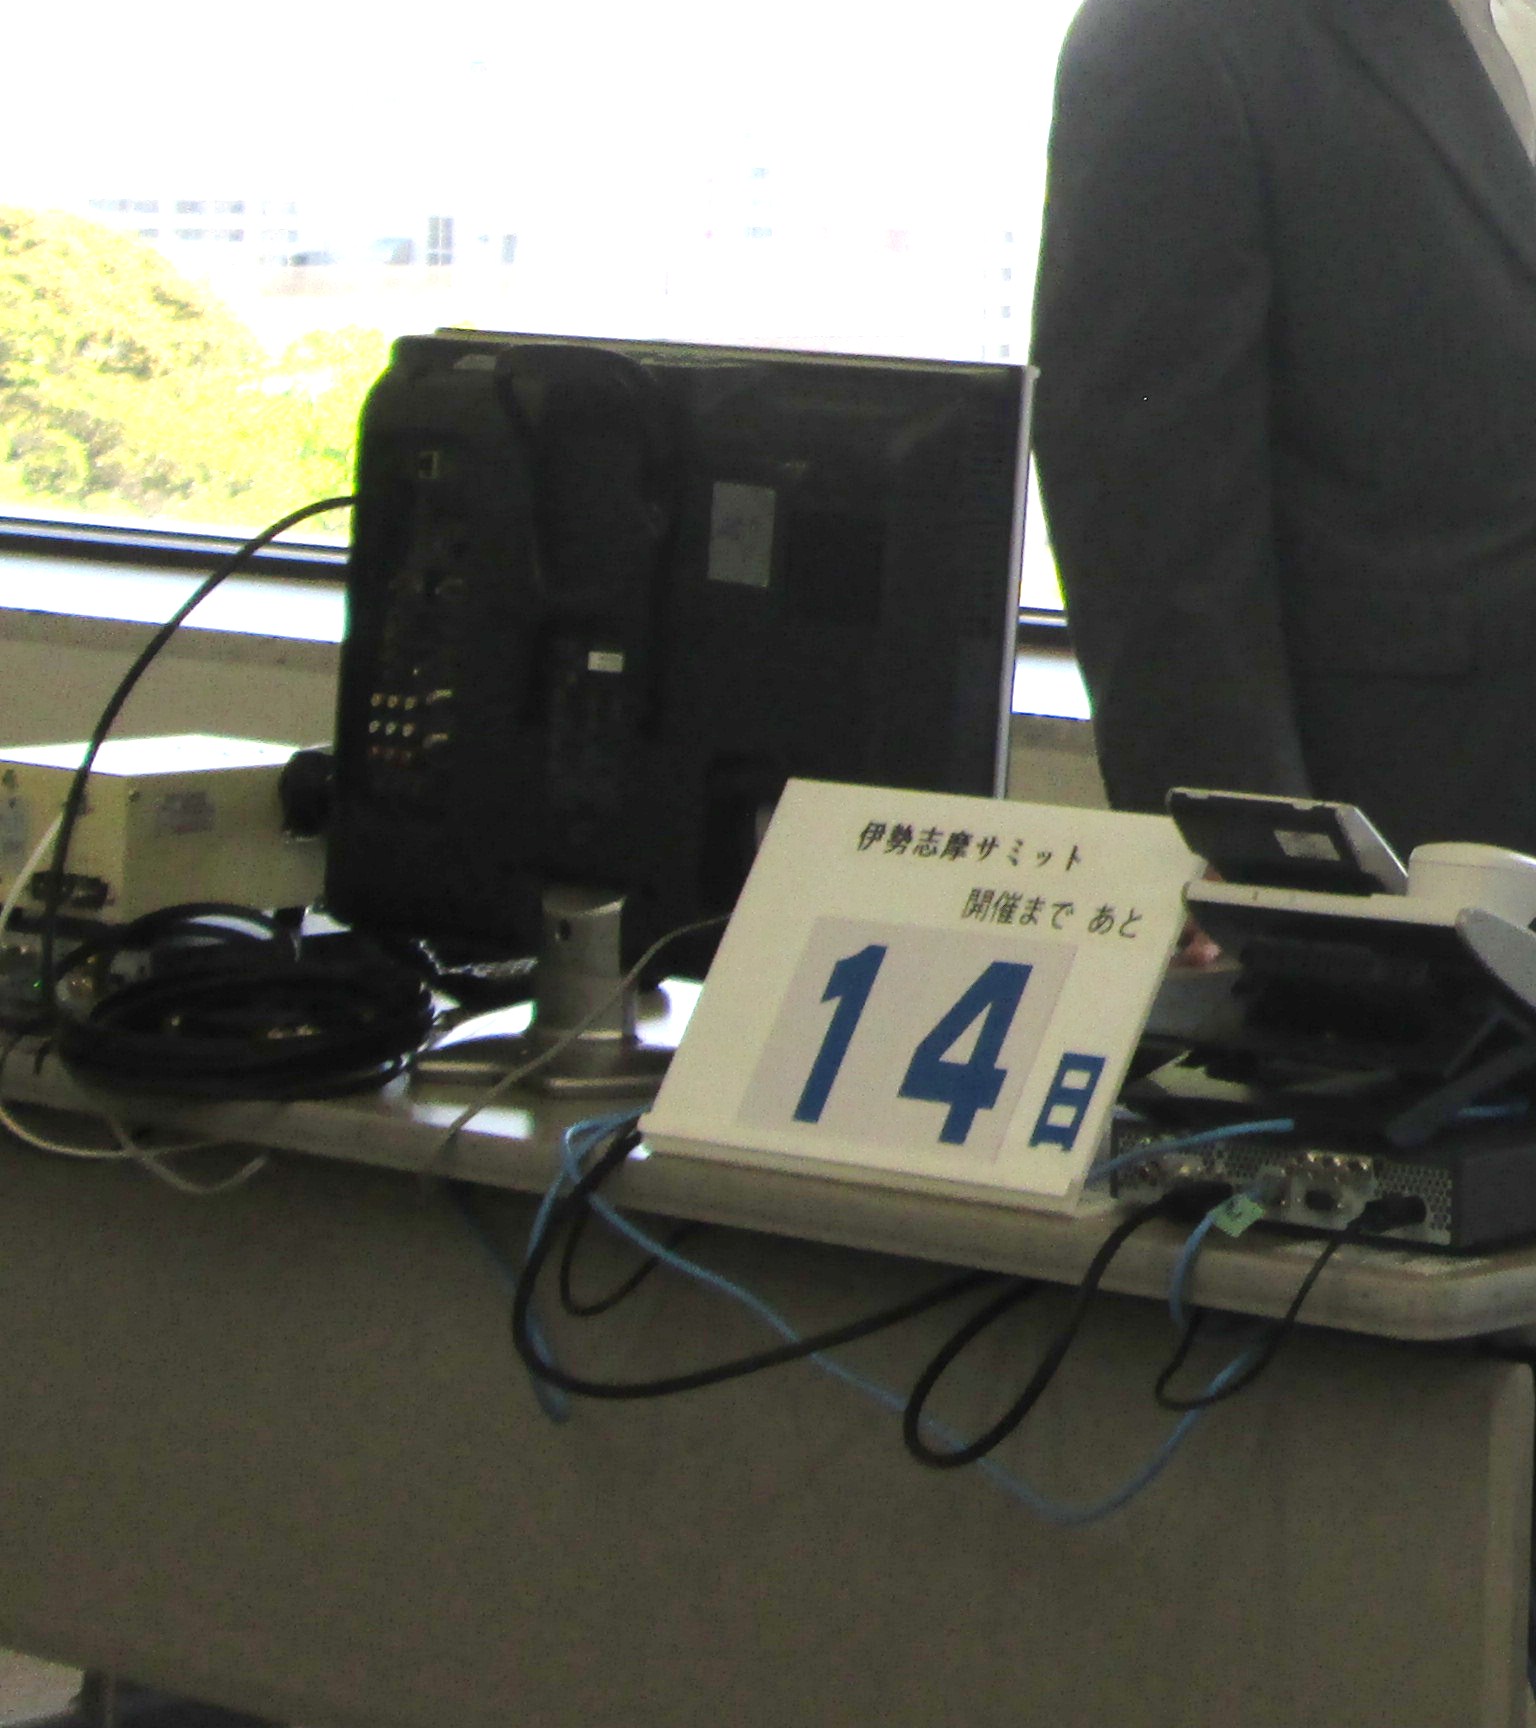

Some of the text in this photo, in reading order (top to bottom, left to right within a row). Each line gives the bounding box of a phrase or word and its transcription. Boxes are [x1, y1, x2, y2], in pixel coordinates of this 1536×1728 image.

[857, 821, 1081, 871] 伊勢志摩サミット
[961, 887, 1143, 940] 開催まで あと
